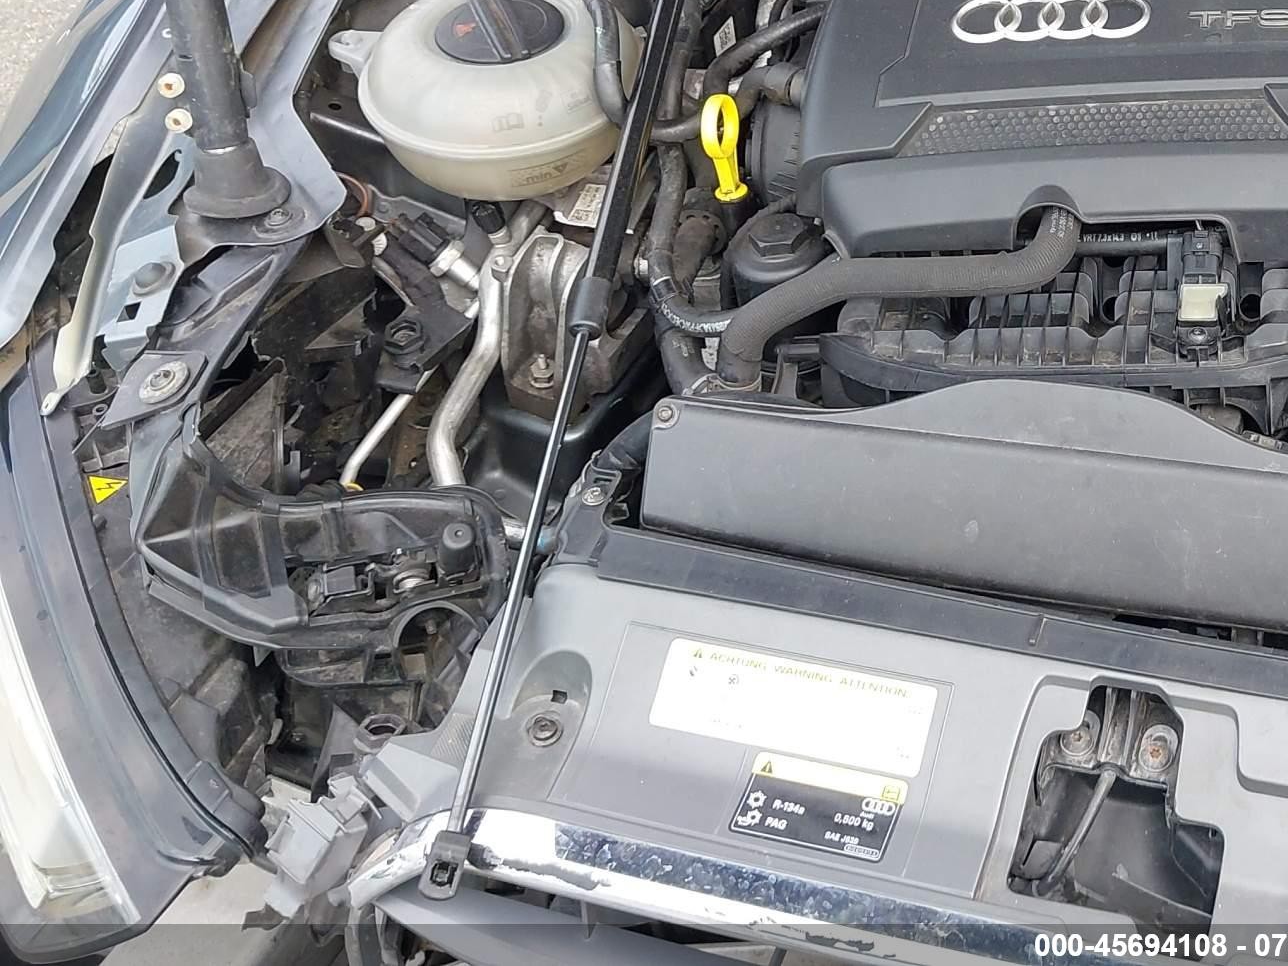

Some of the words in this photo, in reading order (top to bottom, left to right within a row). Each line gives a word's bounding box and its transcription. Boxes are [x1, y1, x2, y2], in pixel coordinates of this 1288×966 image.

[774, 666, 833, 682] WARNING
[772, 800, 805, 815] R-134a
[764, 816, 787, 830] PAG
